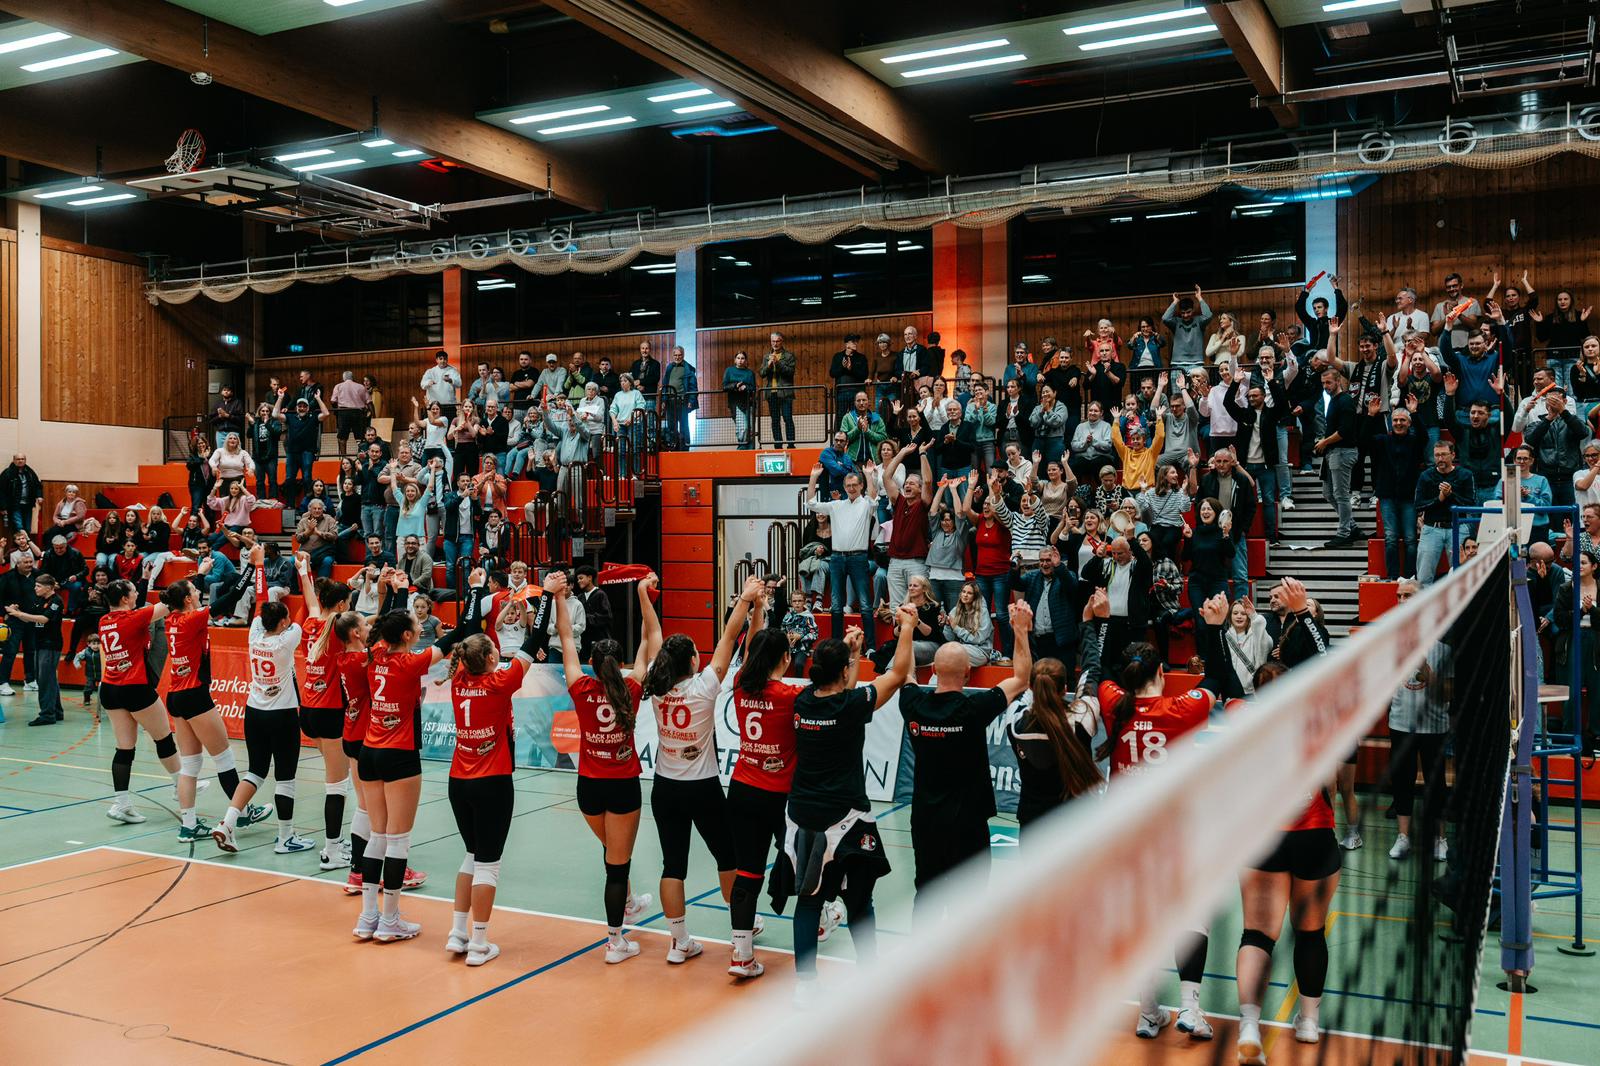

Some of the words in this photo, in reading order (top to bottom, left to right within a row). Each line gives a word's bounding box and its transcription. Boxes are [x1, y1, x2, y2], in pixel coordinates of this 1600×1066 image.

[101, 631, 123, 654] 12
[170, 634, 177, 657] 3
[251, 658, 276, 678] 19
[373, 674, 387, 702] 2
[459, 698, 472, 728] 1
[596, 703, 617, 733] 9
[658, 703, 692, 729] 10
[801, 718, 816, 726] BLACK
[1133, 720, 1153, 730] SEIB
[745, 711, 763, 741] 6
[921, 725, 939, 733] BLACK
[1121, 730, 1168, 765] 18
